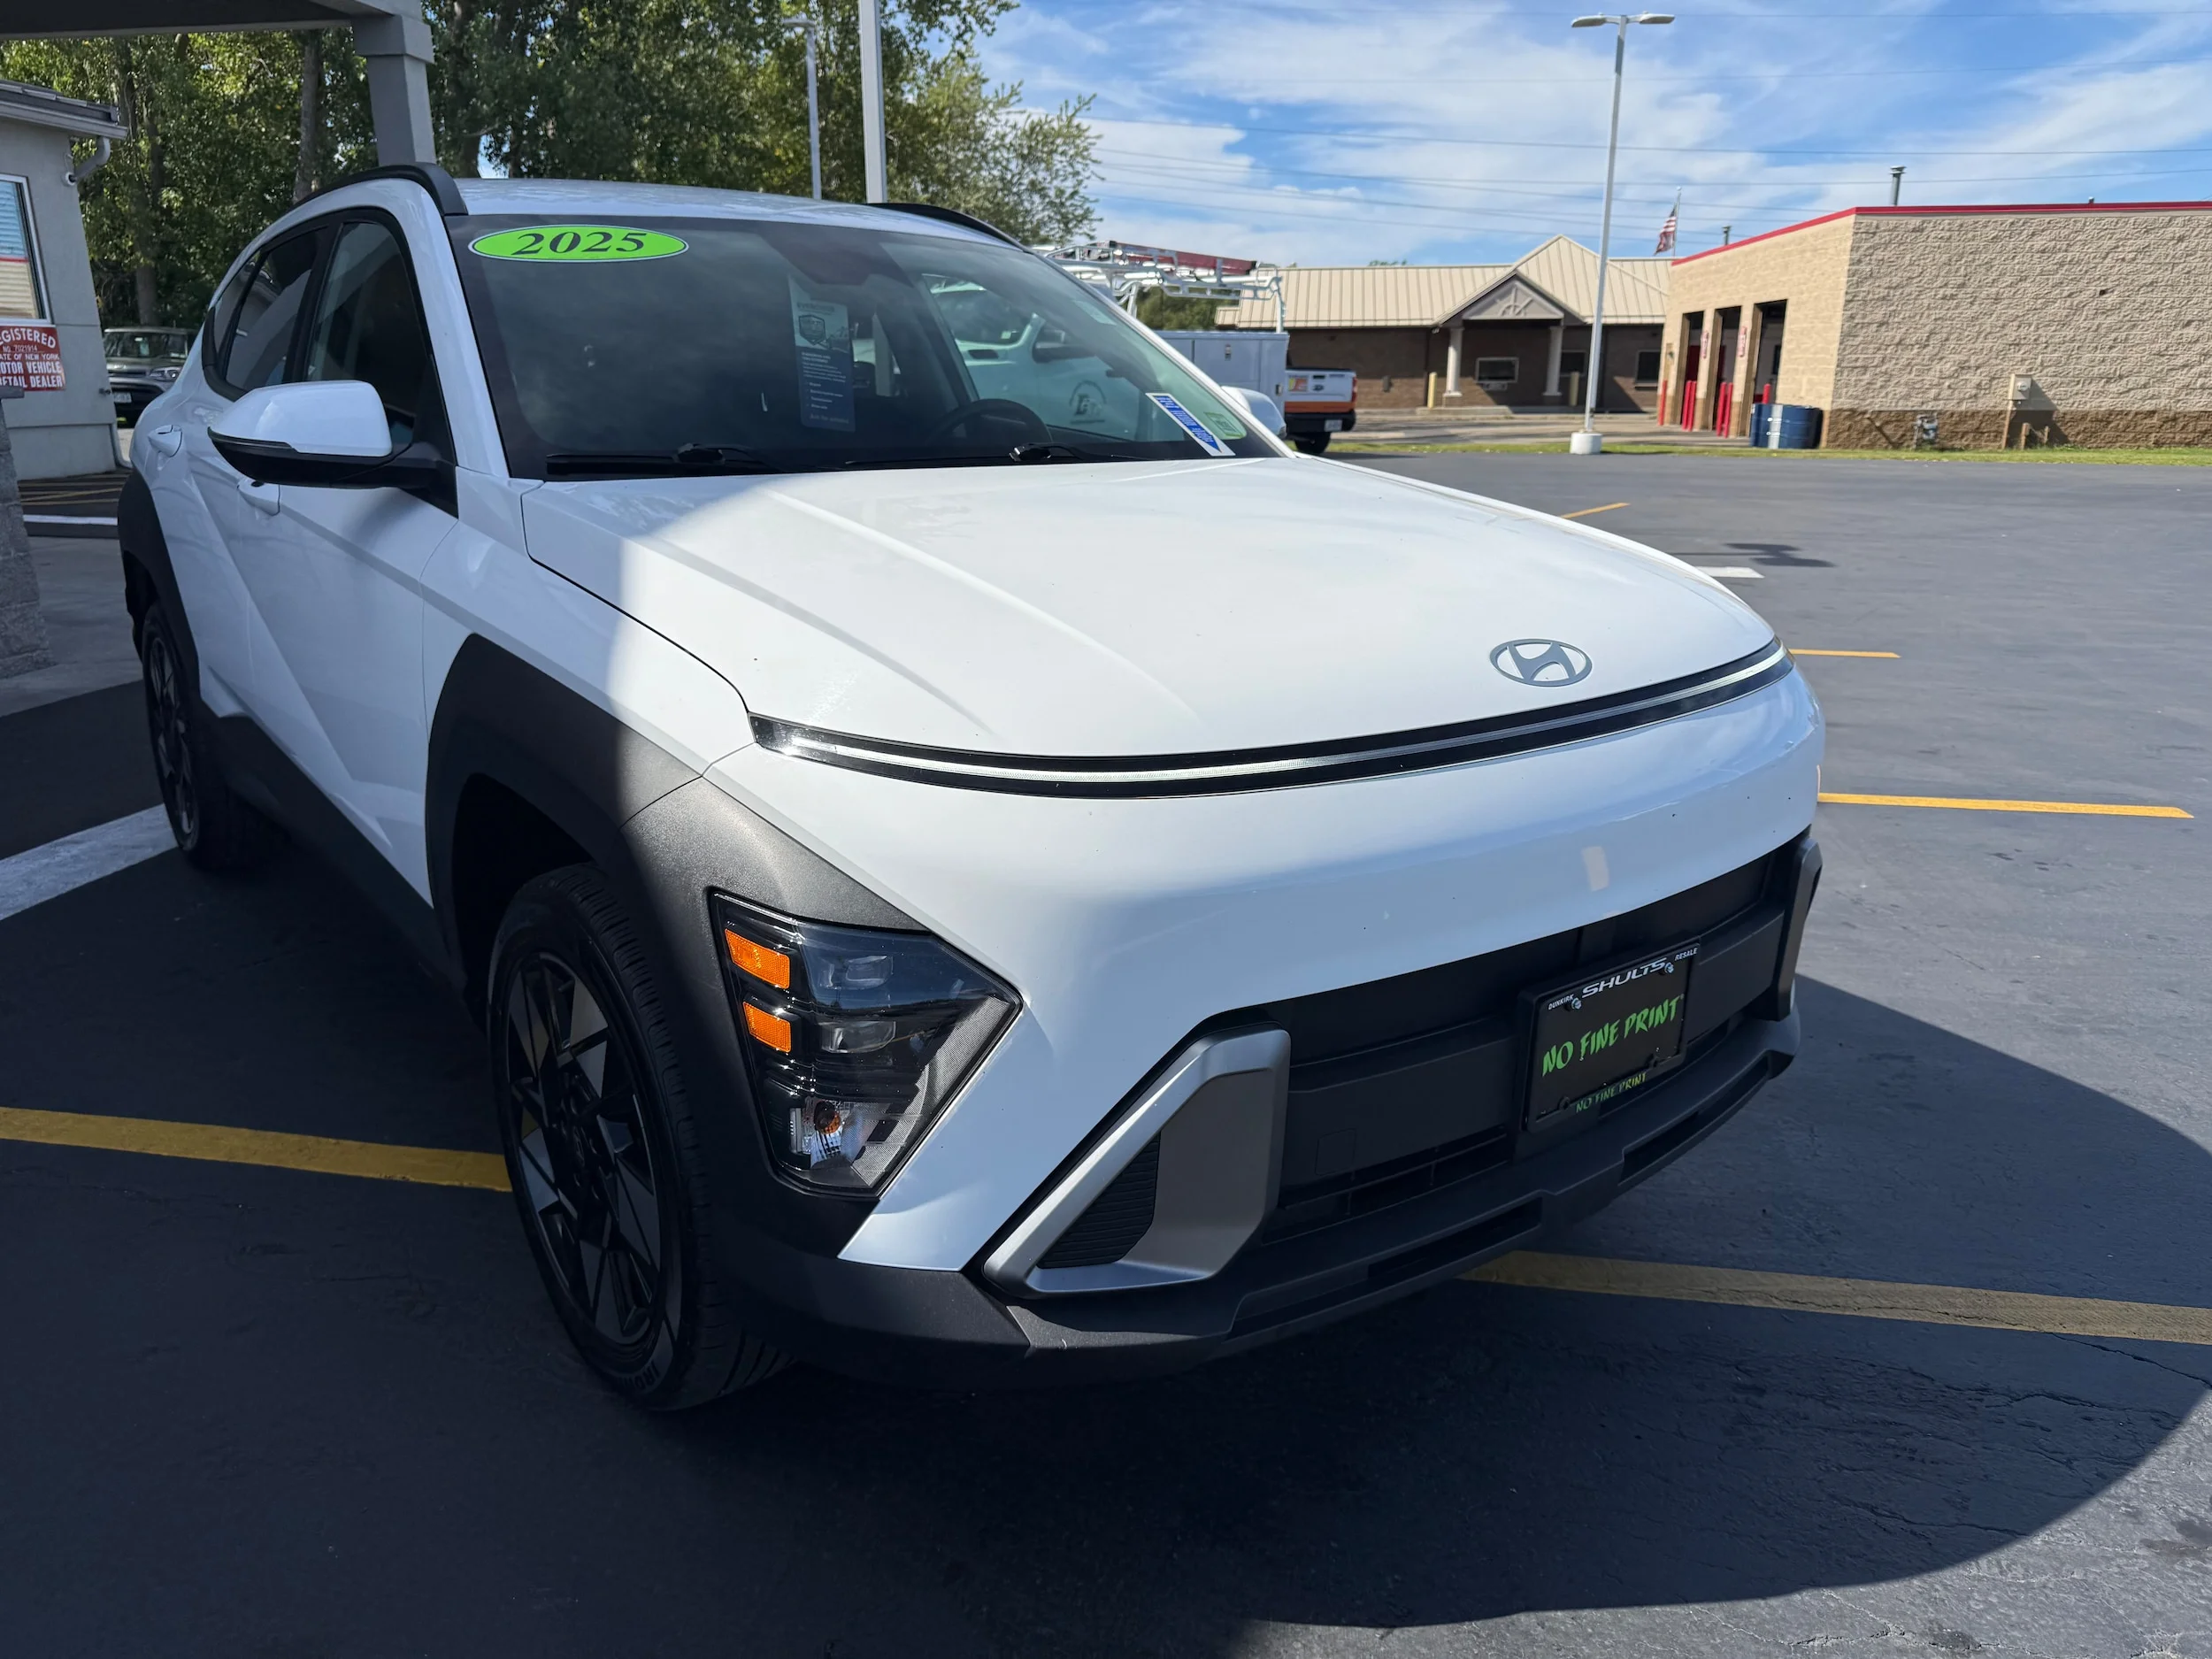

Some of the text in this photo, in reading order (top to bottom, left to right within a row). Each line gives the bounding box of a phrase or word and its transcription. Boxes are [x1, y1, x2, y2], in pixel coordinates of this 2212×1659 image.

[511, 231, 648, 256] 2025
[0, 361, 62, 374] OTOR VEHICLE
[30, 375, 63, 388] DEALER
[1548, 948, 1699, 1010] DUNKIRK SHULTS RESALE
[1542, 995, 1680, 1078] NO FINE PRINT
[1576, 1071, 1647, 1113] NO FINE PRINT
